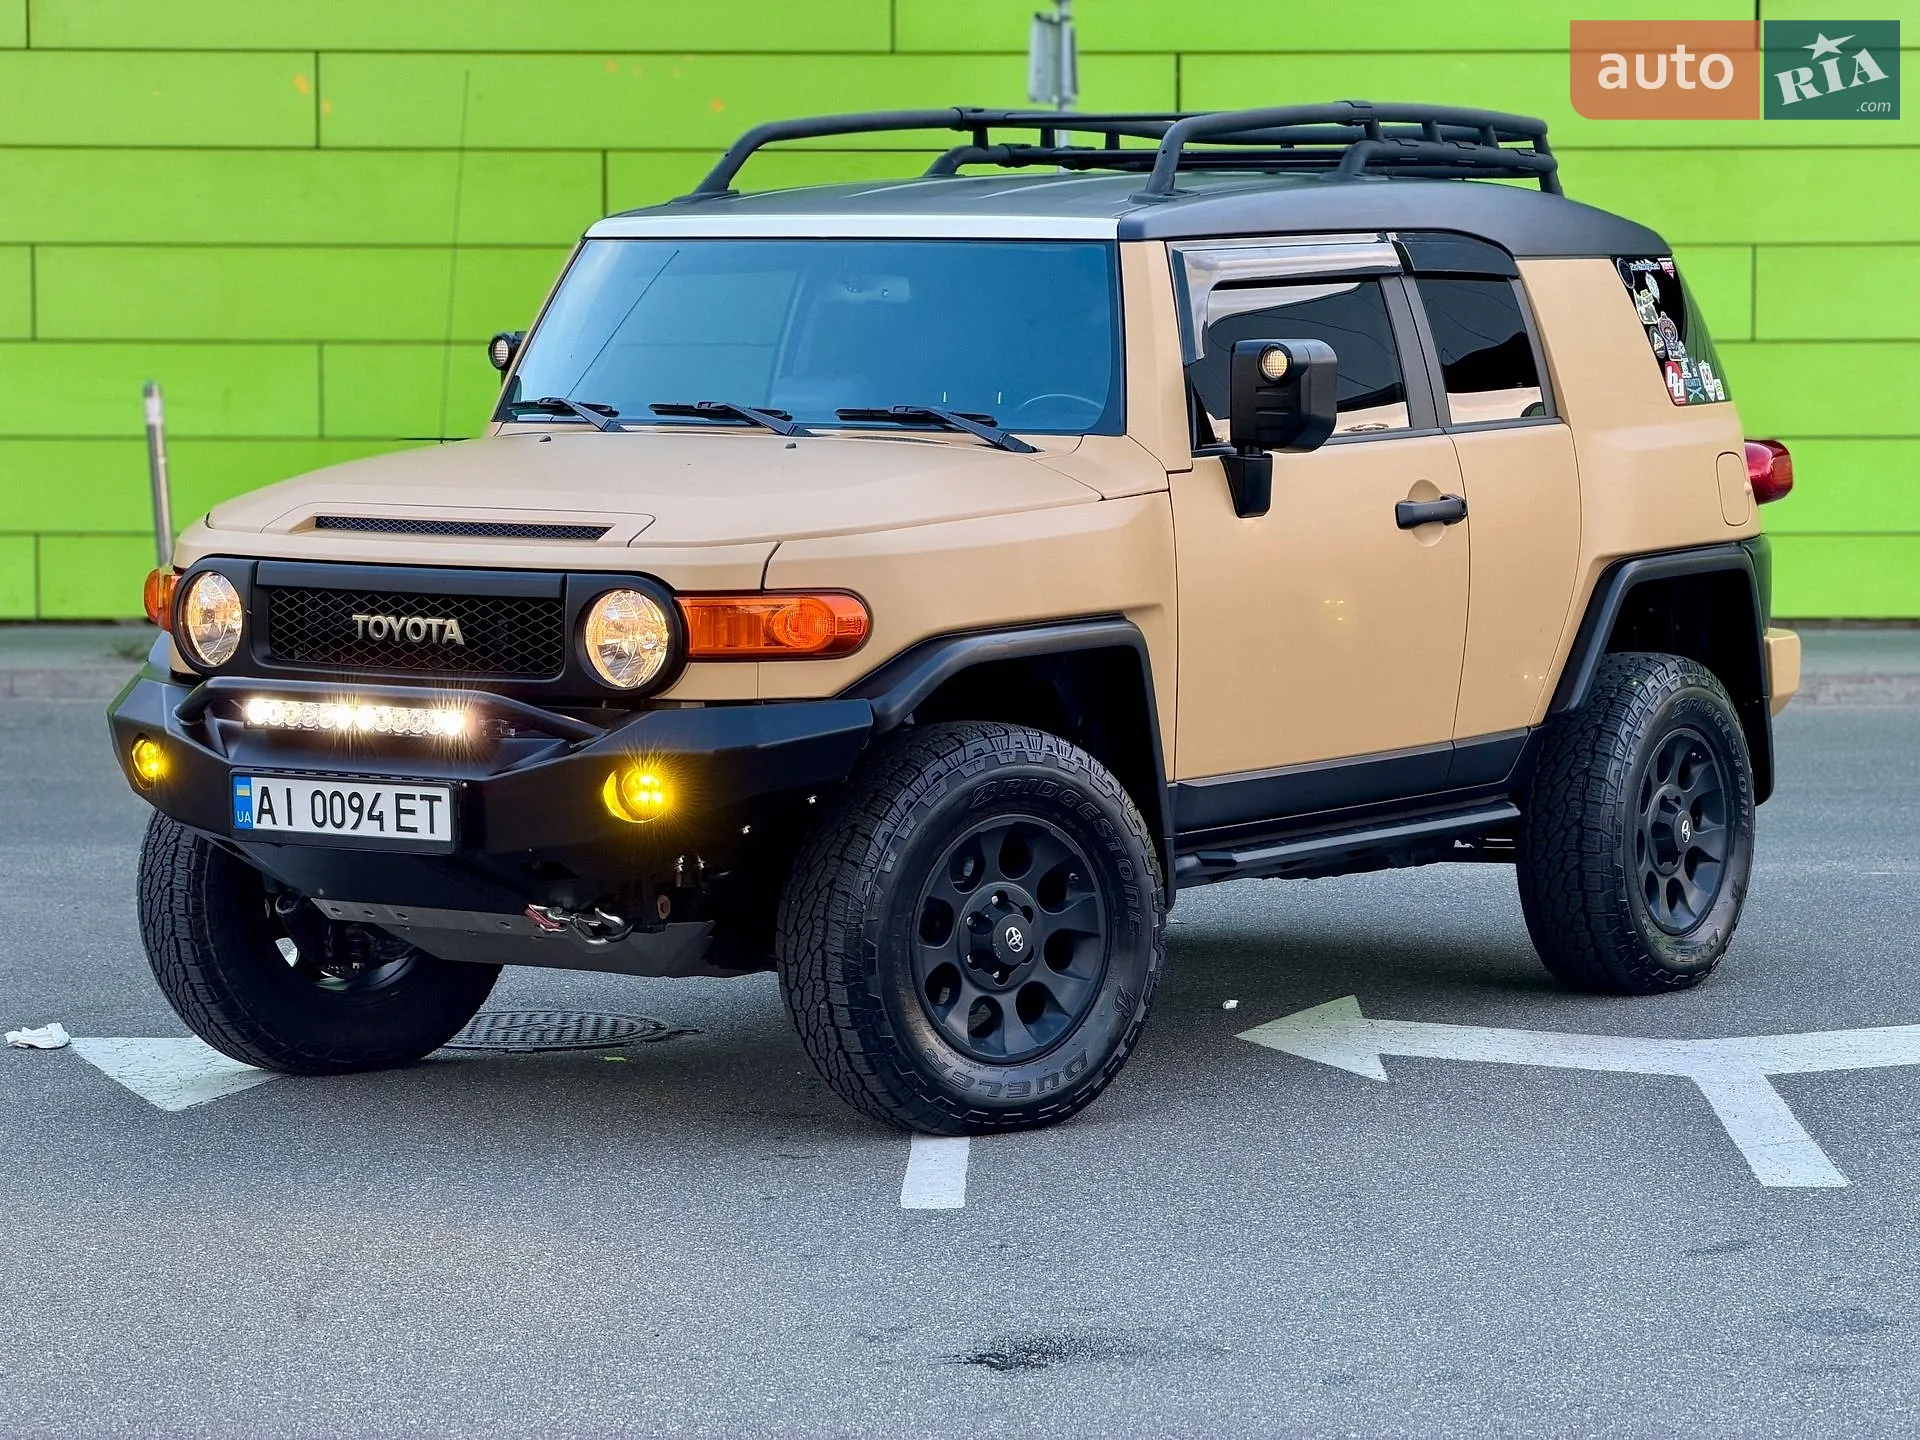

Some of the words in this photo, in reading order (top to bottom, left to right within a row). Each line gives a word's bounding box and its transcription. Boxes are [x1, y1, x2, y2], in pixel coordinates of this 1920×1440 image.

[352, 614, 466, 646] TOYOTA
[237, 811, 251, 823] UA
[256, 787, 293, 826] AI
[310, 789, 385, 832] 0094
[395, 793, 443, 834] ET
[970, 778, 1144, 936] BRIDGESTONE
[923, 1048, 1089, 1099] DUELER
